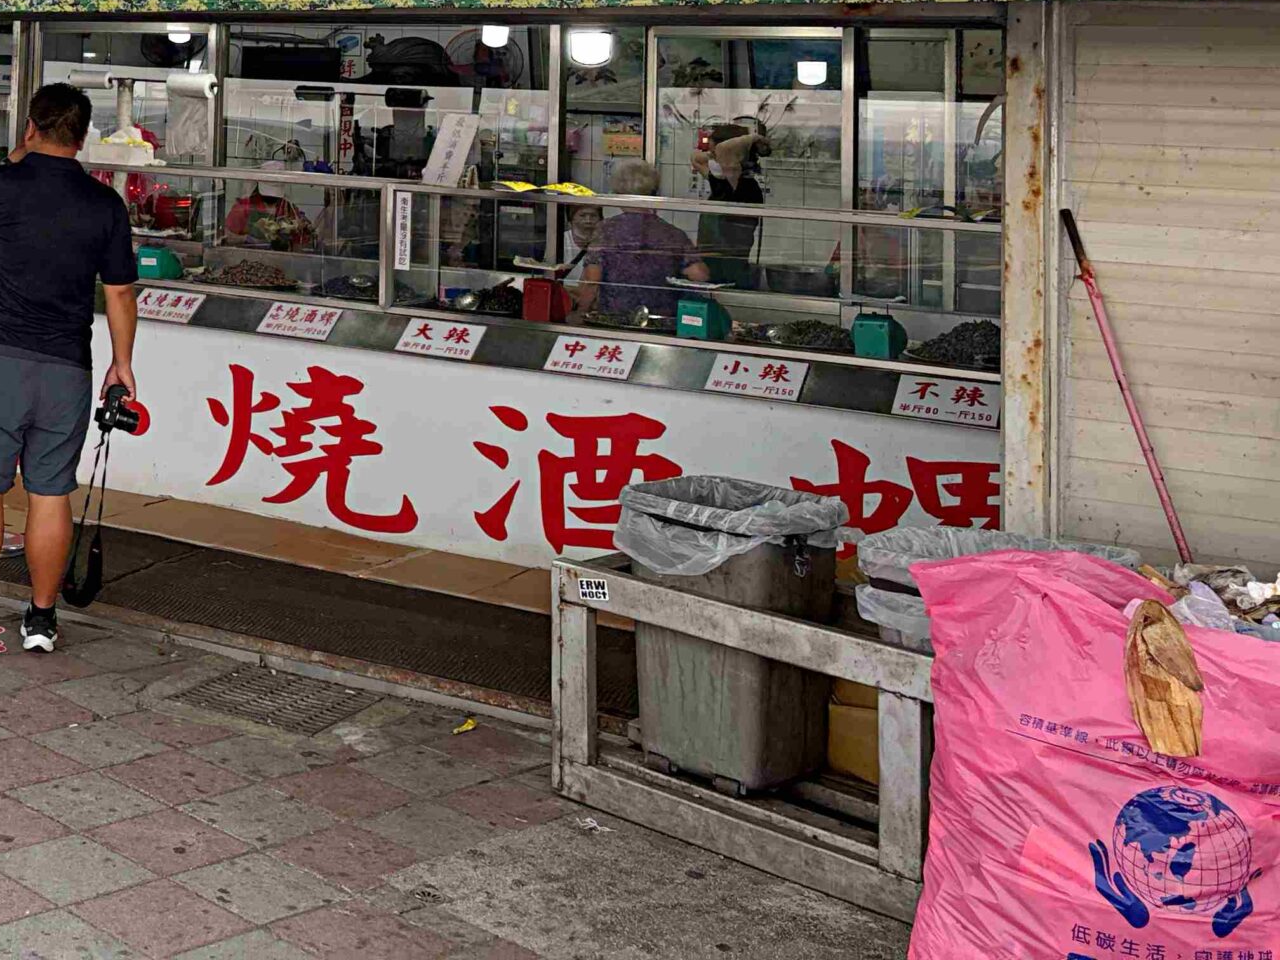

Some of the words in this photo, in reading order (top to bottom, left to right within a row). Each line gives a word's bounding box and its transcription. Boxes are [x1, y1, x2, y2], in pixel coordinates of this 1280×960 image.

[414, 323, 471, 345] 大辣
[564, 340, 624, 363] 中辣
[723, 359, 792, 383] 小辣
[909, 381, 990, 408] 不辣
[580, 580, 606, 591] ERW
